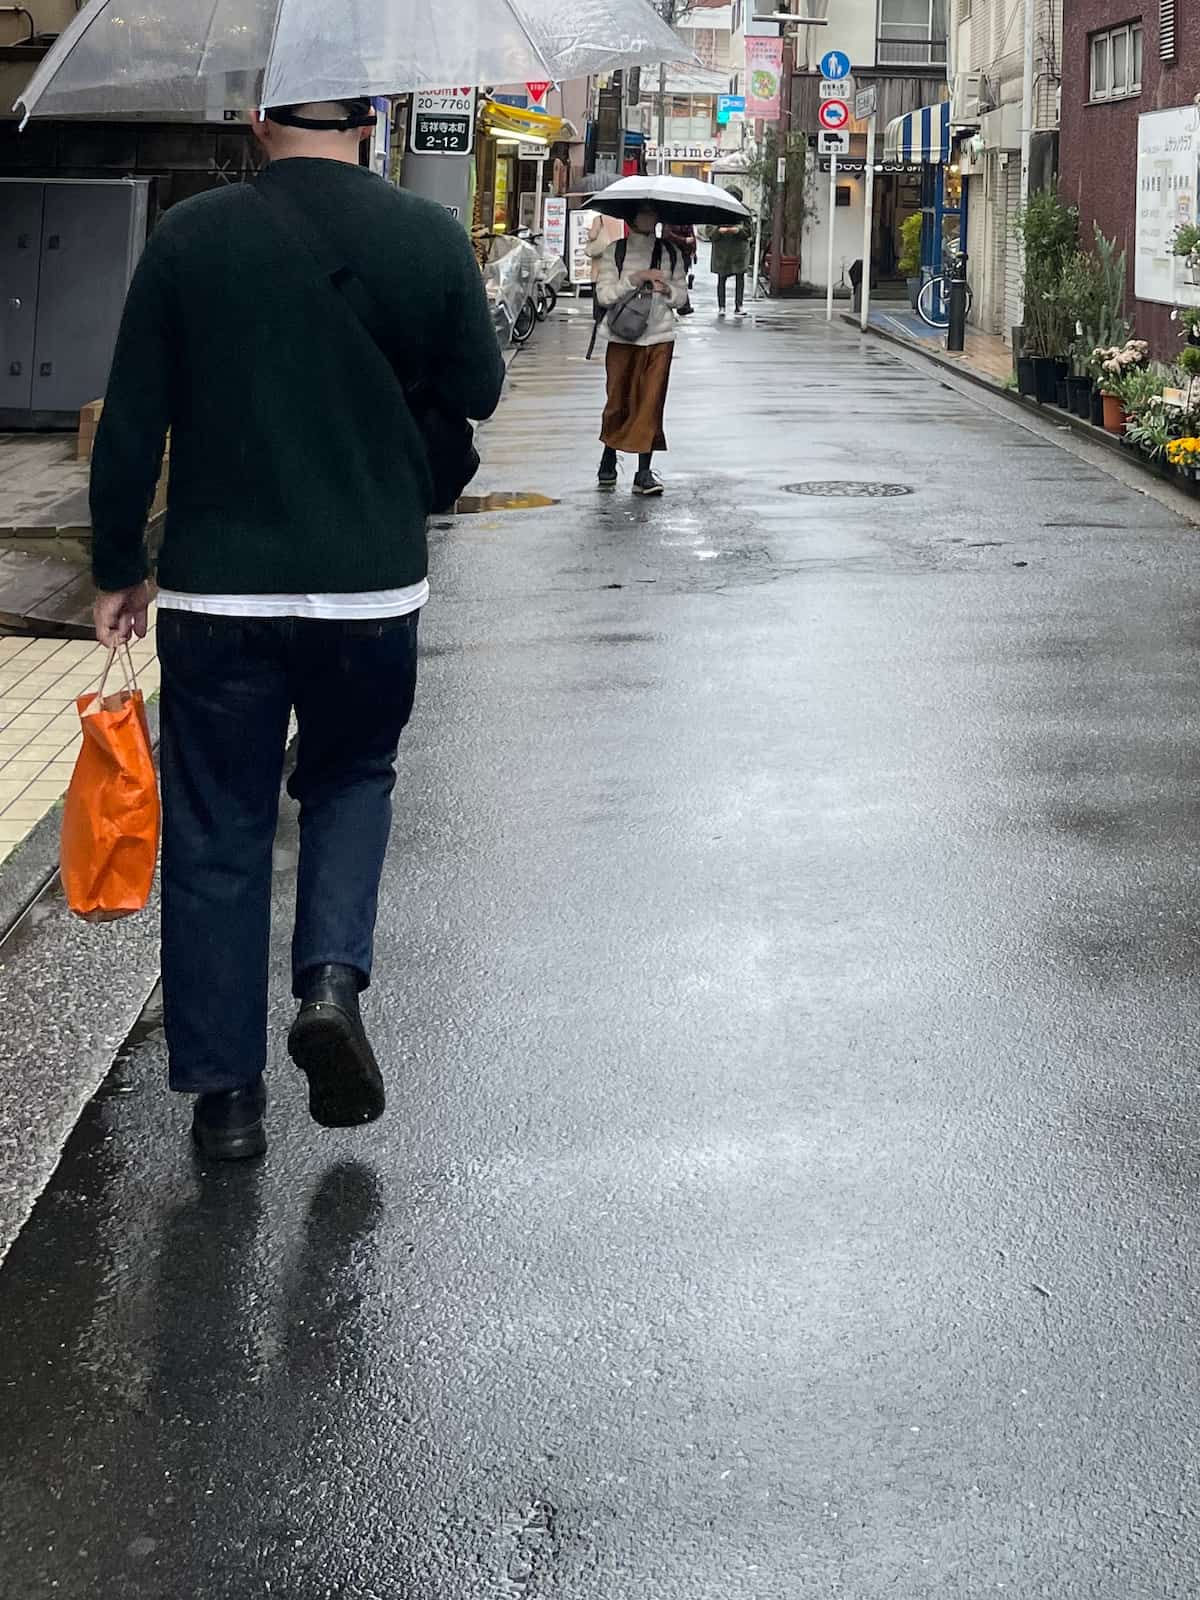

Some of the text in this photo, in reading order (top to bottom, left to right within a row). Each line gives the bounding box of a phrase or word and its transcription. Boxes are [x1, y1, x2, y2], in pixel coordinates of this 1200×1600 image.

[529, 83, 546, 91] STOP
[418, 98, 471, 110] 20-7760
[420, 121, 466, 134] 吉祥寺本町
[426, 136, 459, 148] 2-12
